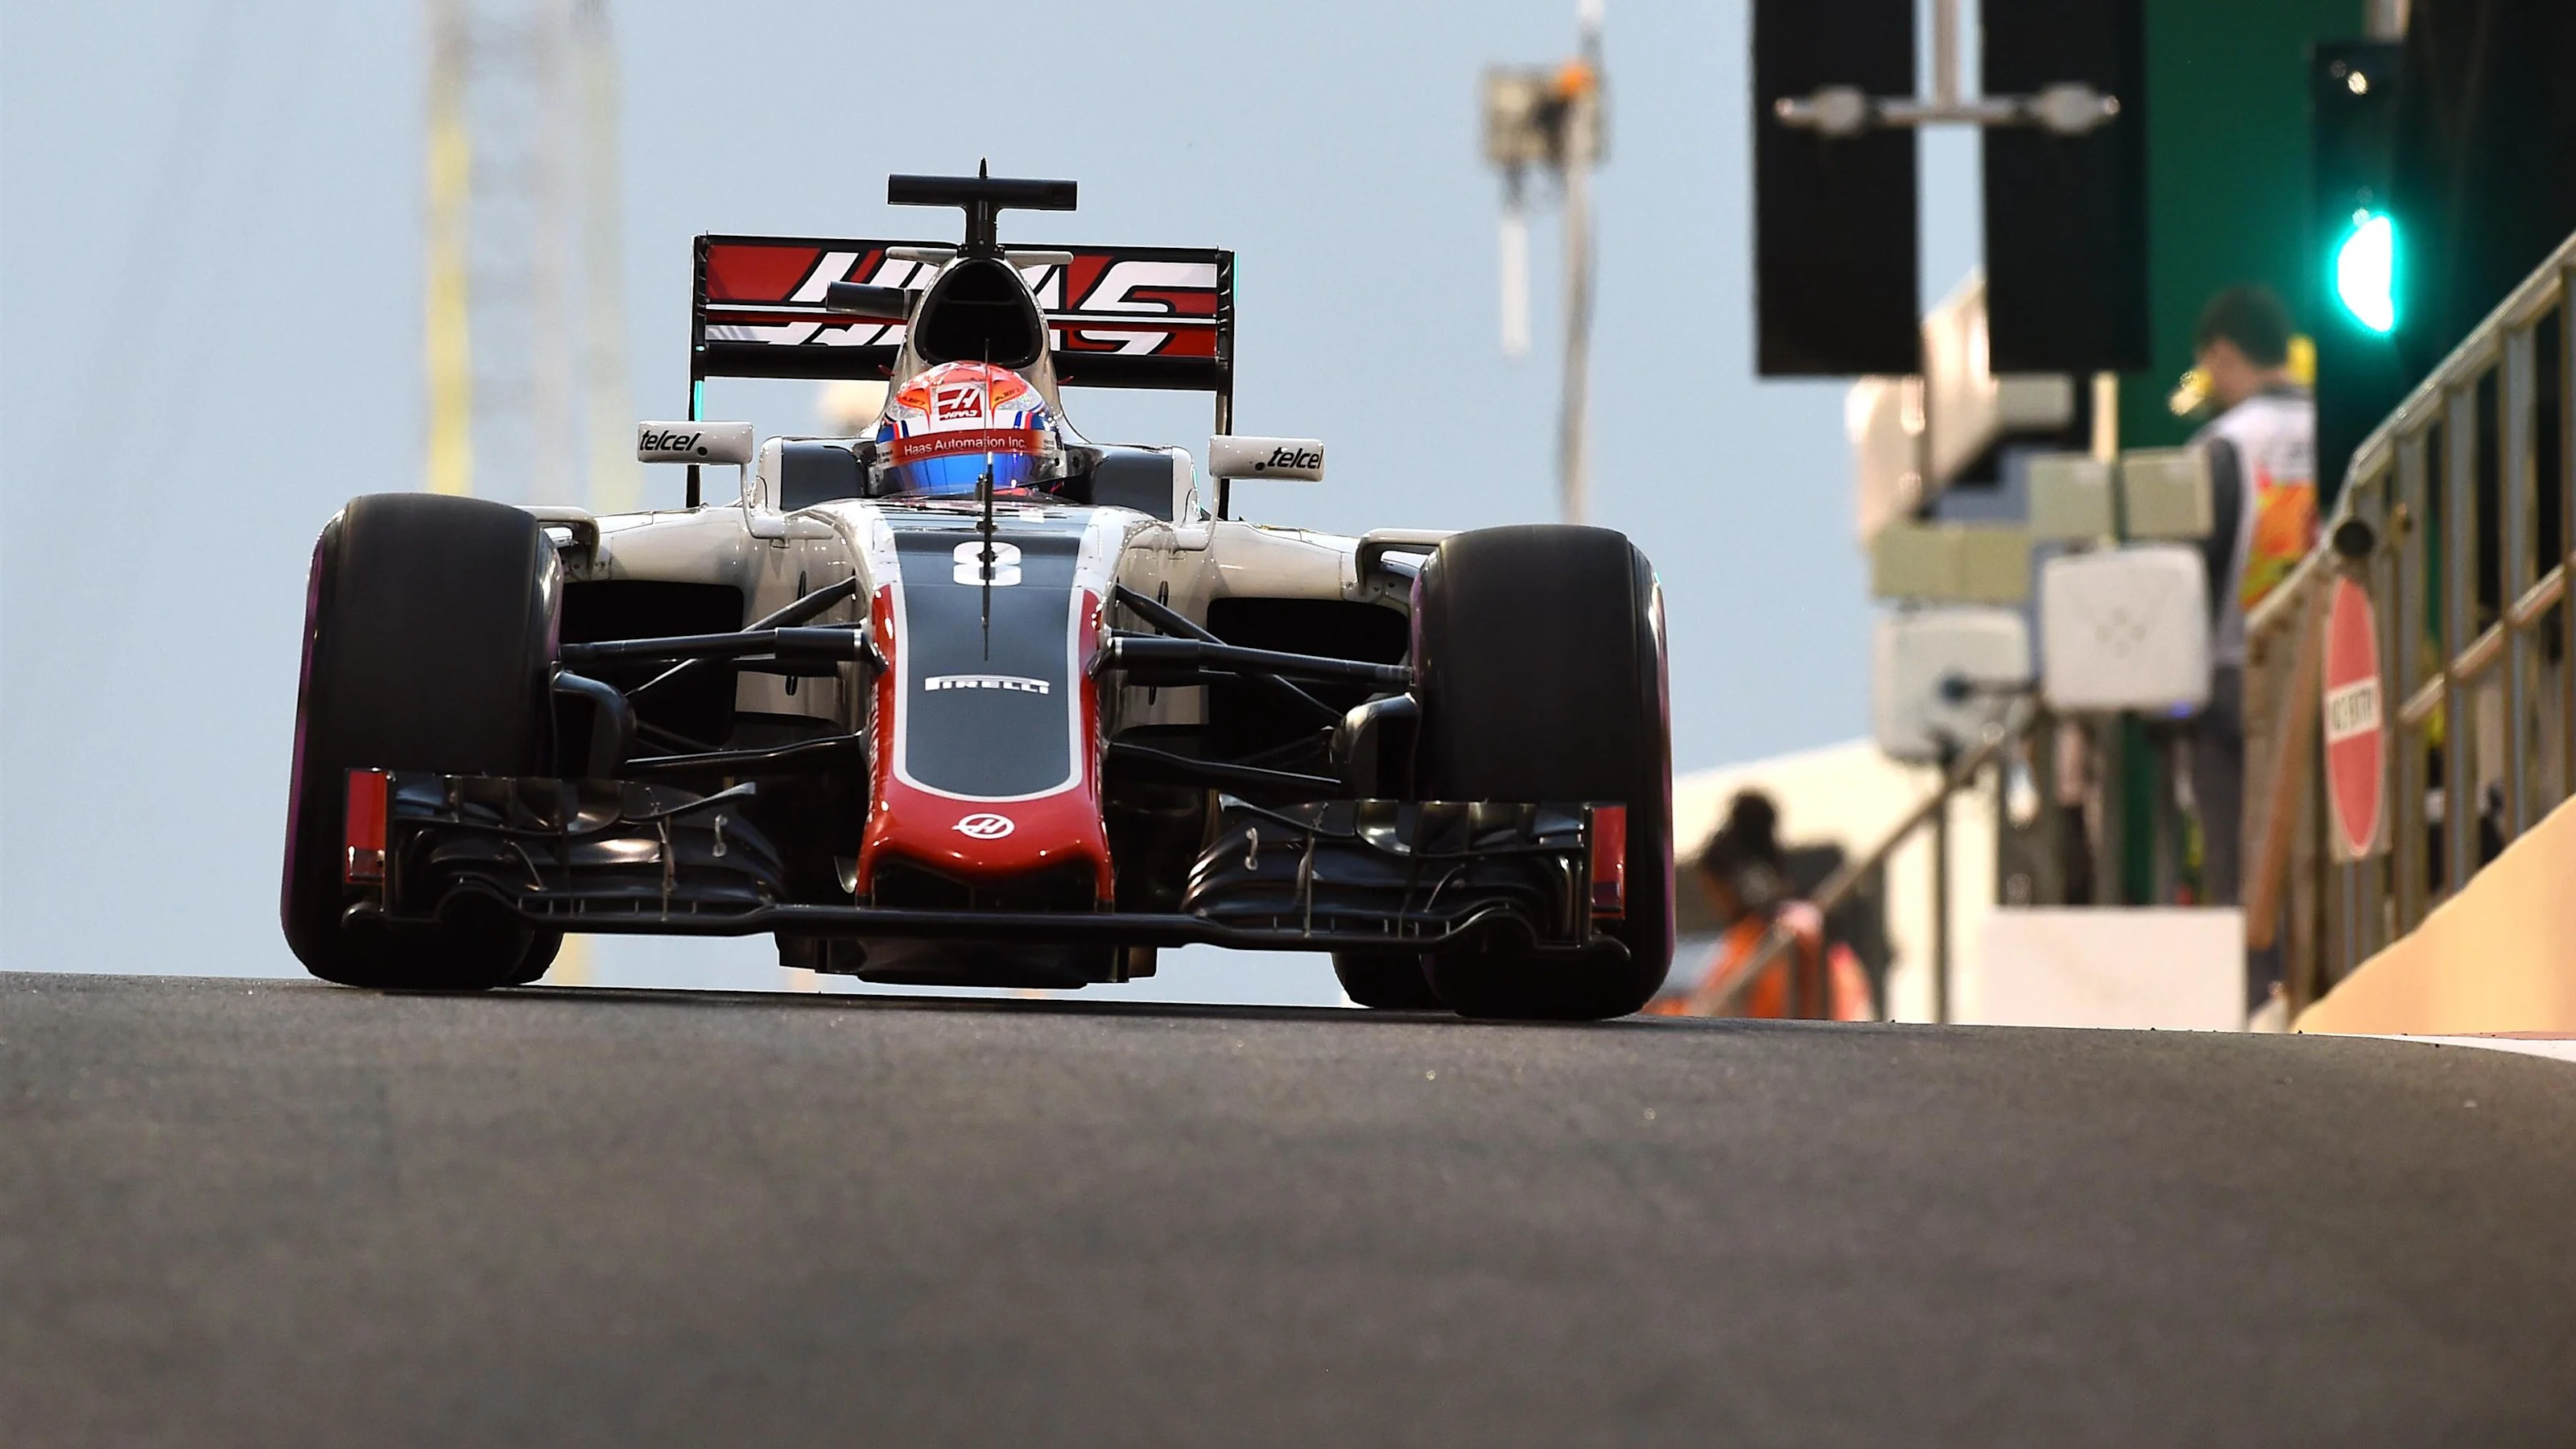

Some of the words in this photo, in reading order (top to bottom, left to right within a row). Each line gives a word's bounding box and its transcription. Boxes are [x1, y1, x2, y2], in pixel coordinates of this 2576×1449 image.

[904, 444, 932, 456] Haas
[1008, 436, 1027, 448] Inc.
[925, 674, 1050, 695] PIRELLI
